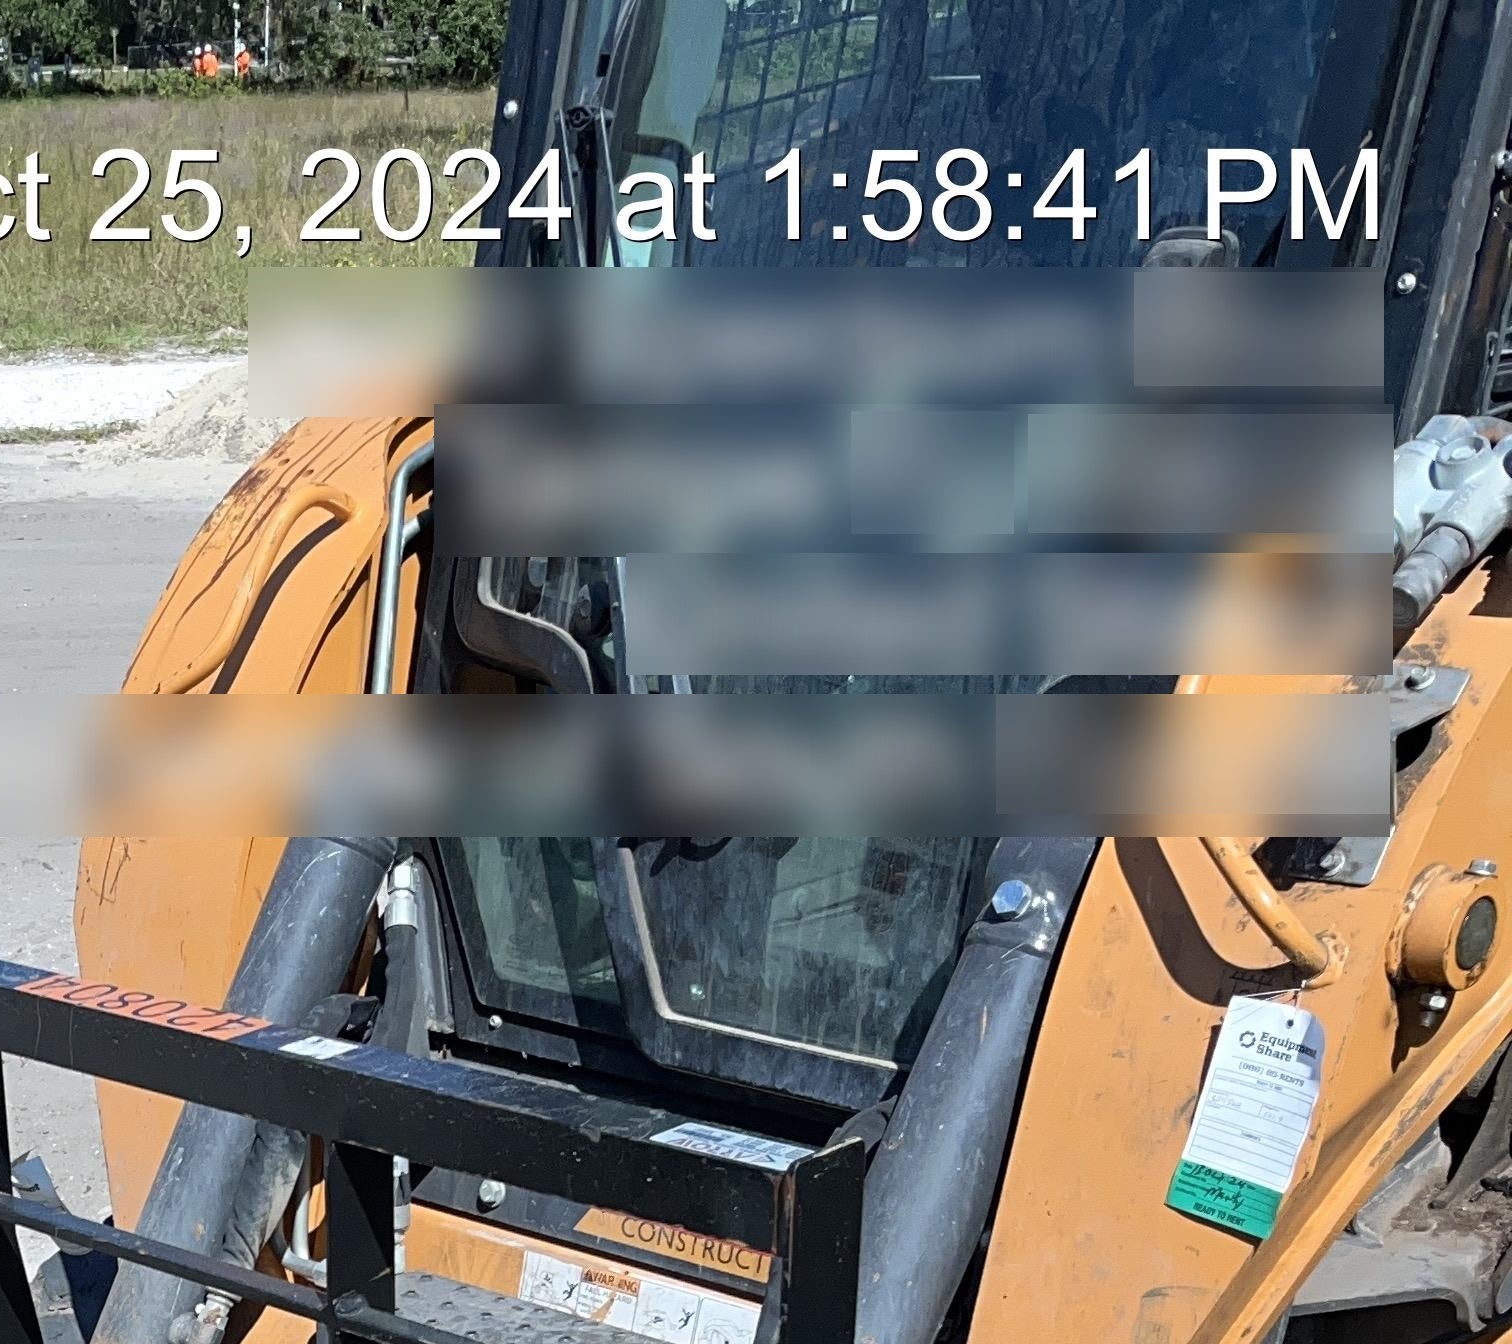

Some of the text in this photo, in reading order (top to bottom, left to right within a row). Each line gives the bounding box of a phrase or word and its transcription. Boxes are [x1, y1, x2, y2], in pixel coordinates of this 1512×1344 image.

[37, 974, 255, 1034] 420804
[1256, 1043, 1292, 1062] Share
[1260, 1031, 1317, 1060] Equipment
